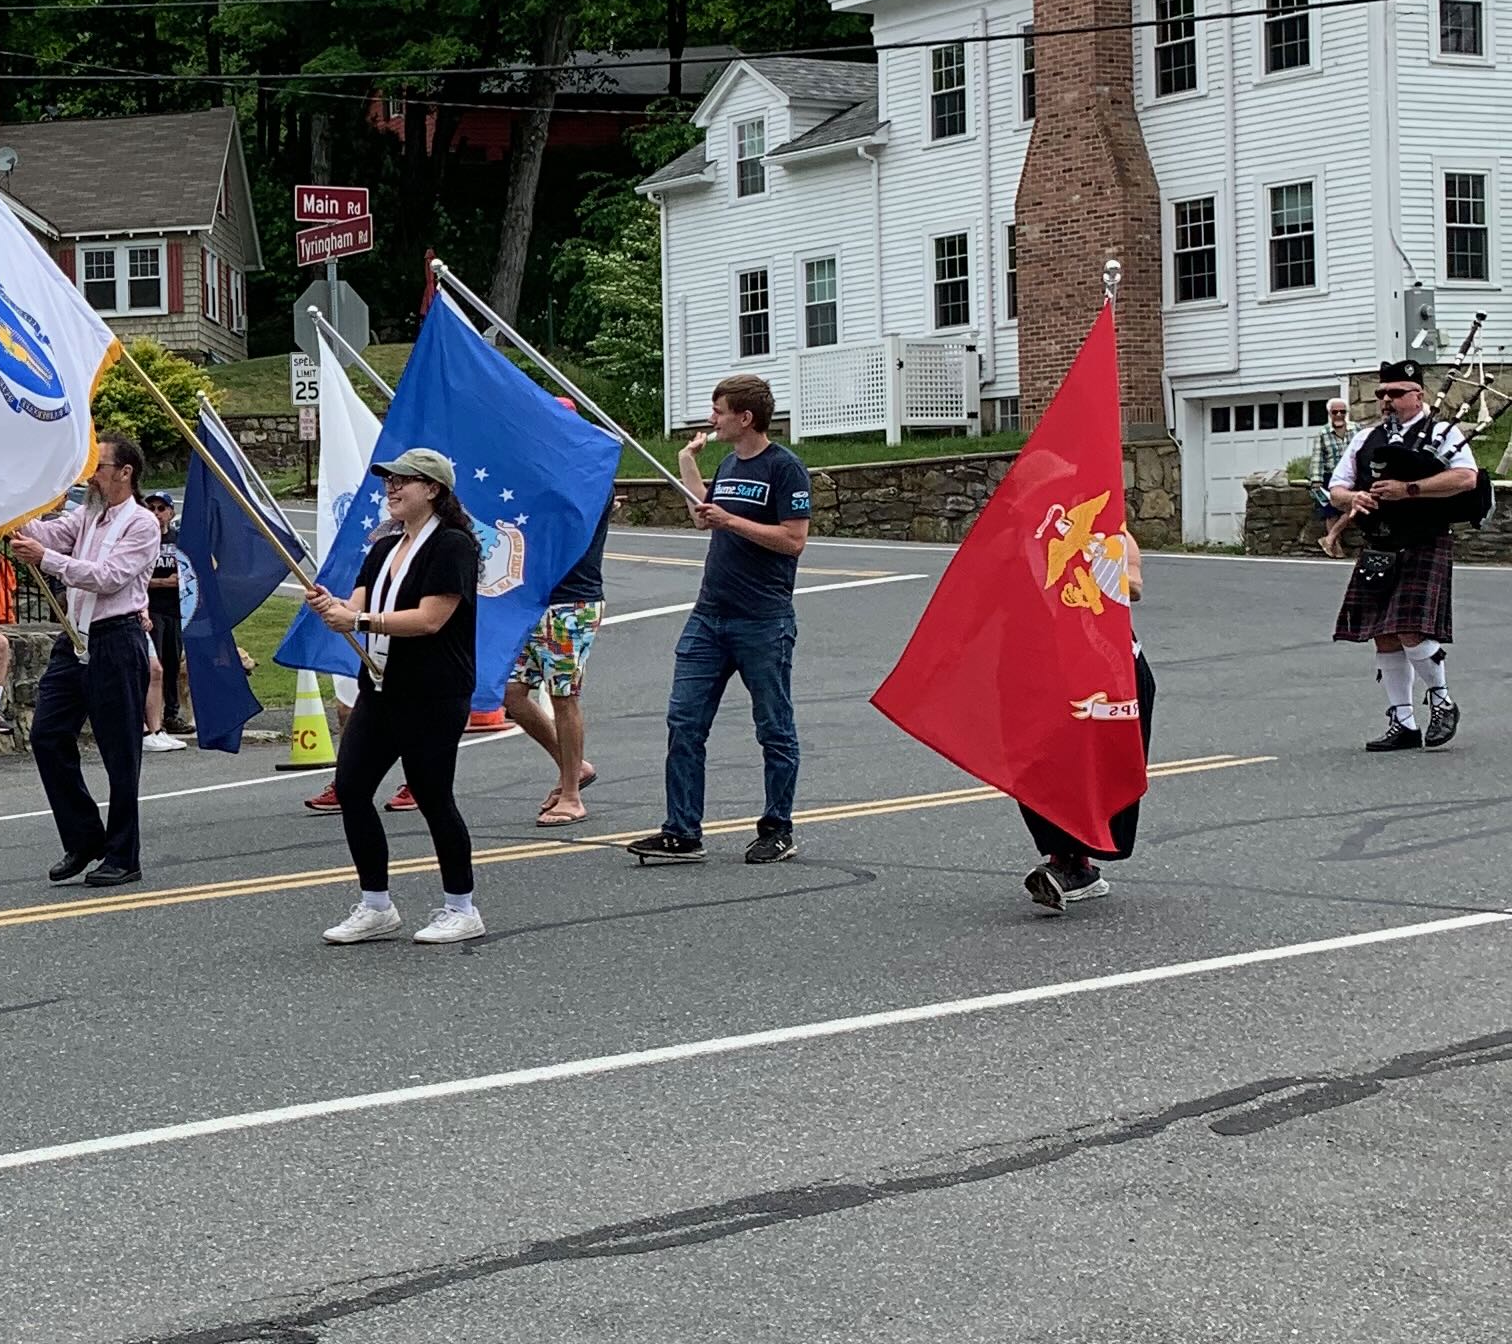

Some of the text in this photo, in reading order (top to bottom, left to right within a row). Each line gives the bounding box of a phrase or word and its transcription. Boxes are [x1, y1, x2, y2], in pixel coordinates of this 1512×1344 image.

[303, 193, 361, 215] Main Rd
[300, 230, 368, 261] Tyringham Rd
[296, 369, 317, 377] LIMIT
[295, 381, 319, 401] 25
